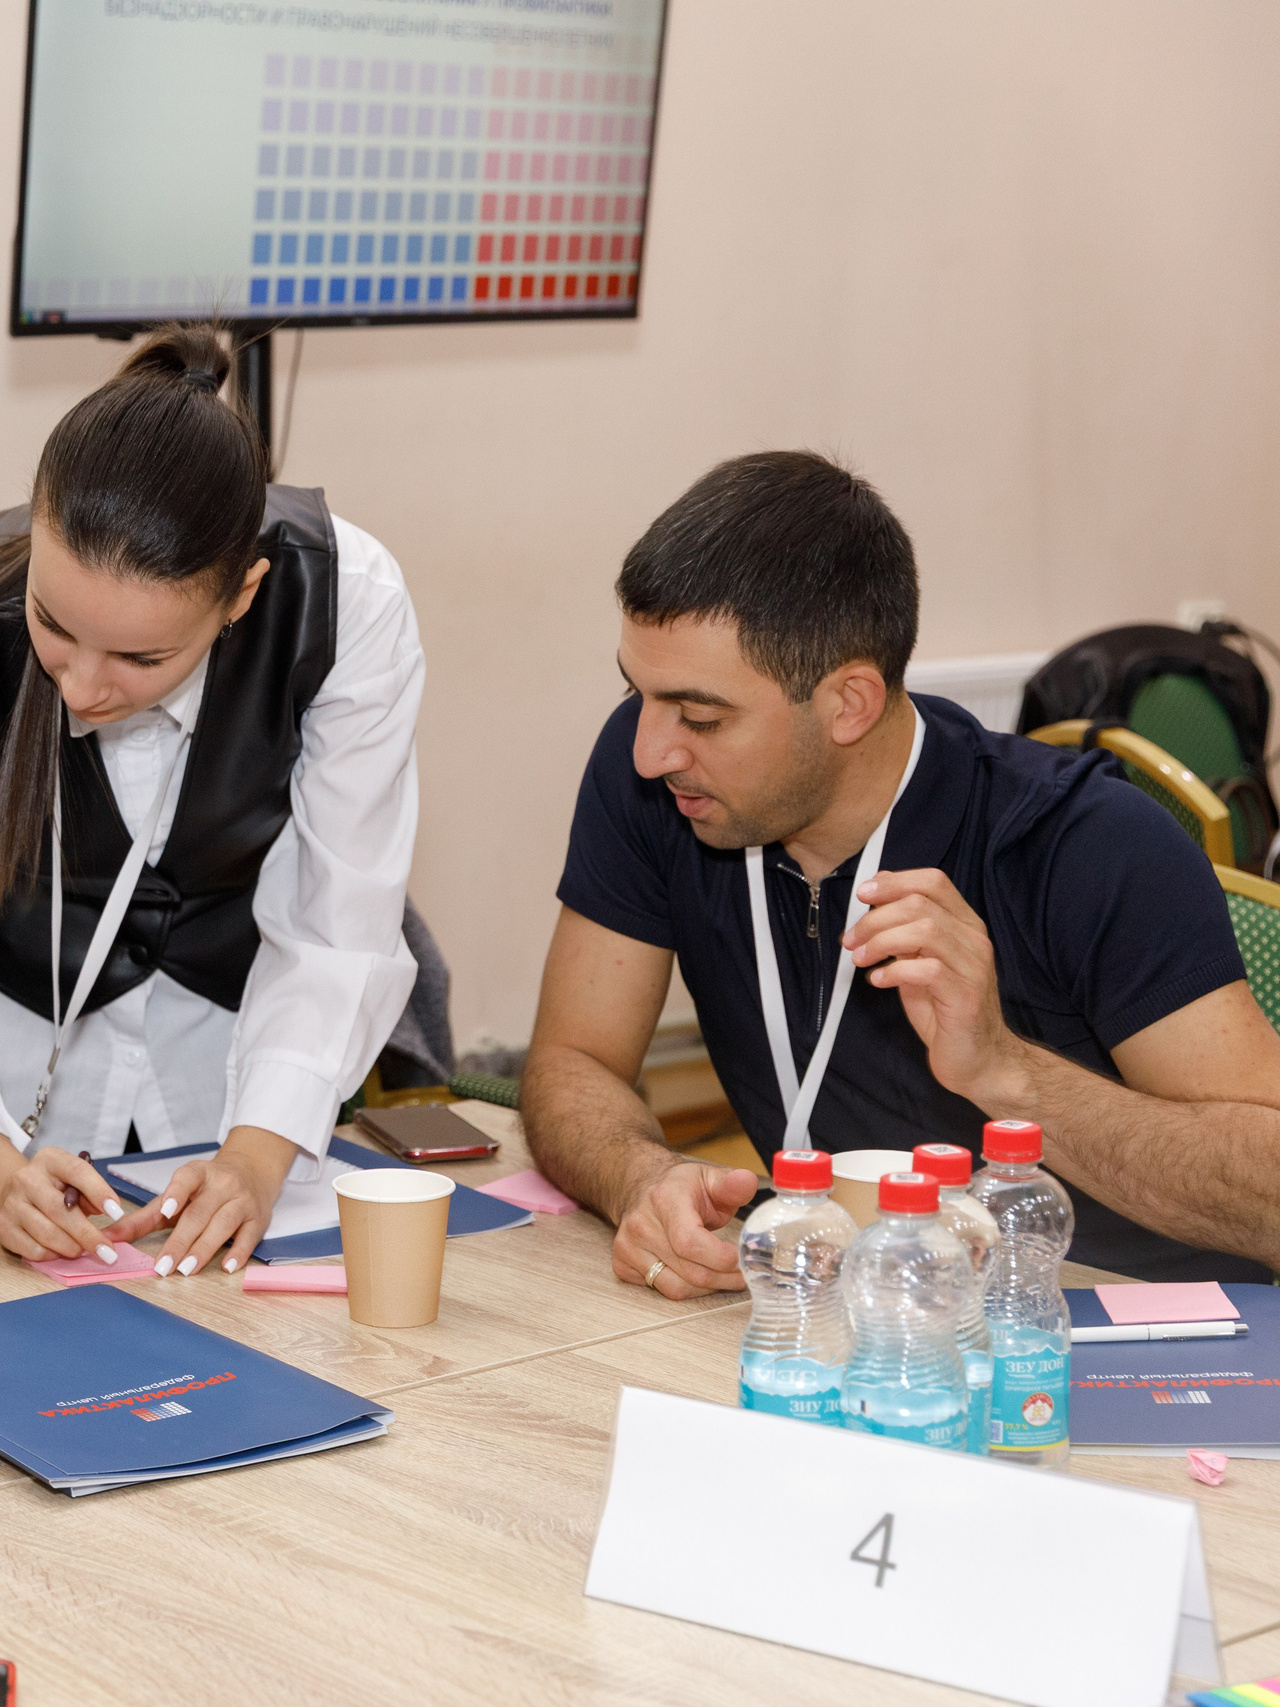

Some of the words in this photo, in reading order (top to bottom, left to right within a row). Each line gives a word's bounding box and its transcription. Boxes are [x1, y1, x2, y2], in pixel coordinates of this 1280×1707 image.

[1069, 1378, 1280, 1388] РОФИЛАКТИК
[1140, 1371, 1255, 1380] федеральный
[36, 1371, 238, 1418] ПРОФИЛАКТИКА
[100, 1374, 196, 1401] федеральный
[56, 1396, 99, 1408] центр
[850, 1512, 898, 1588] 4
